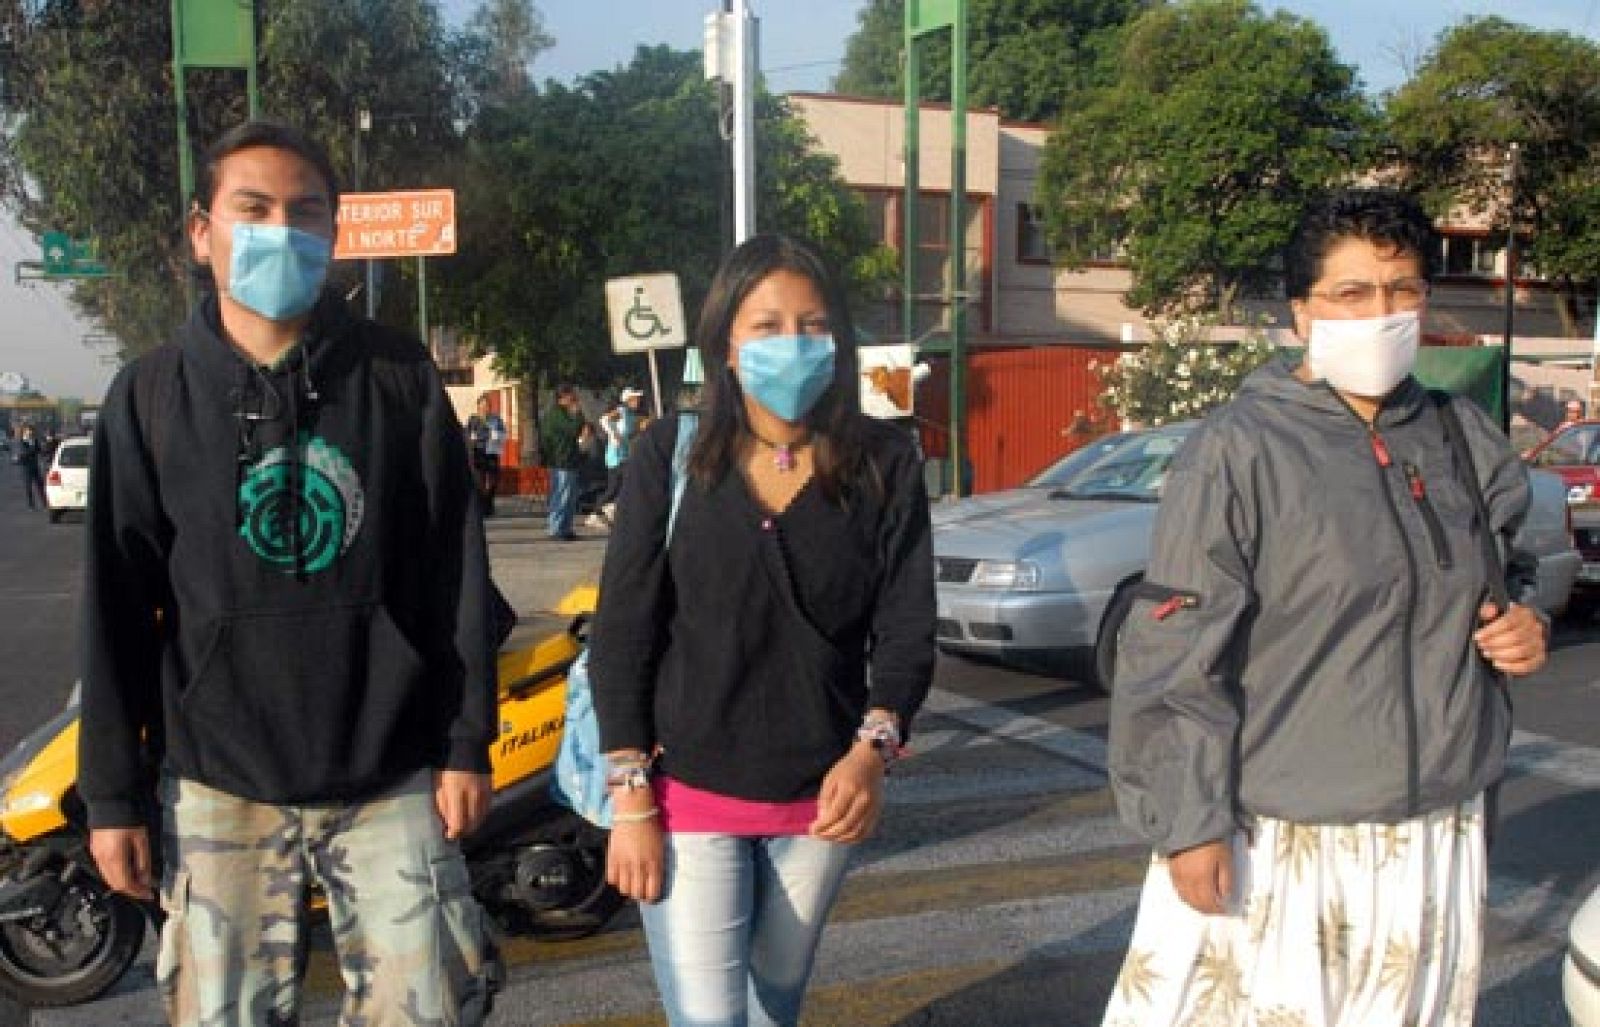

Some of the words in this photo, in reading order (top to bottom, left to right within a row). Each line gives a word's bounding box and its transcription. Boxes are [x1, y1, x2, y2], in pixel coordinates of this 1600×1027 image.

[337, 202, 402, 224] TERIOR
[411, 200, 443, 219] SUR
[359, 229, 417, 248] NORTE
